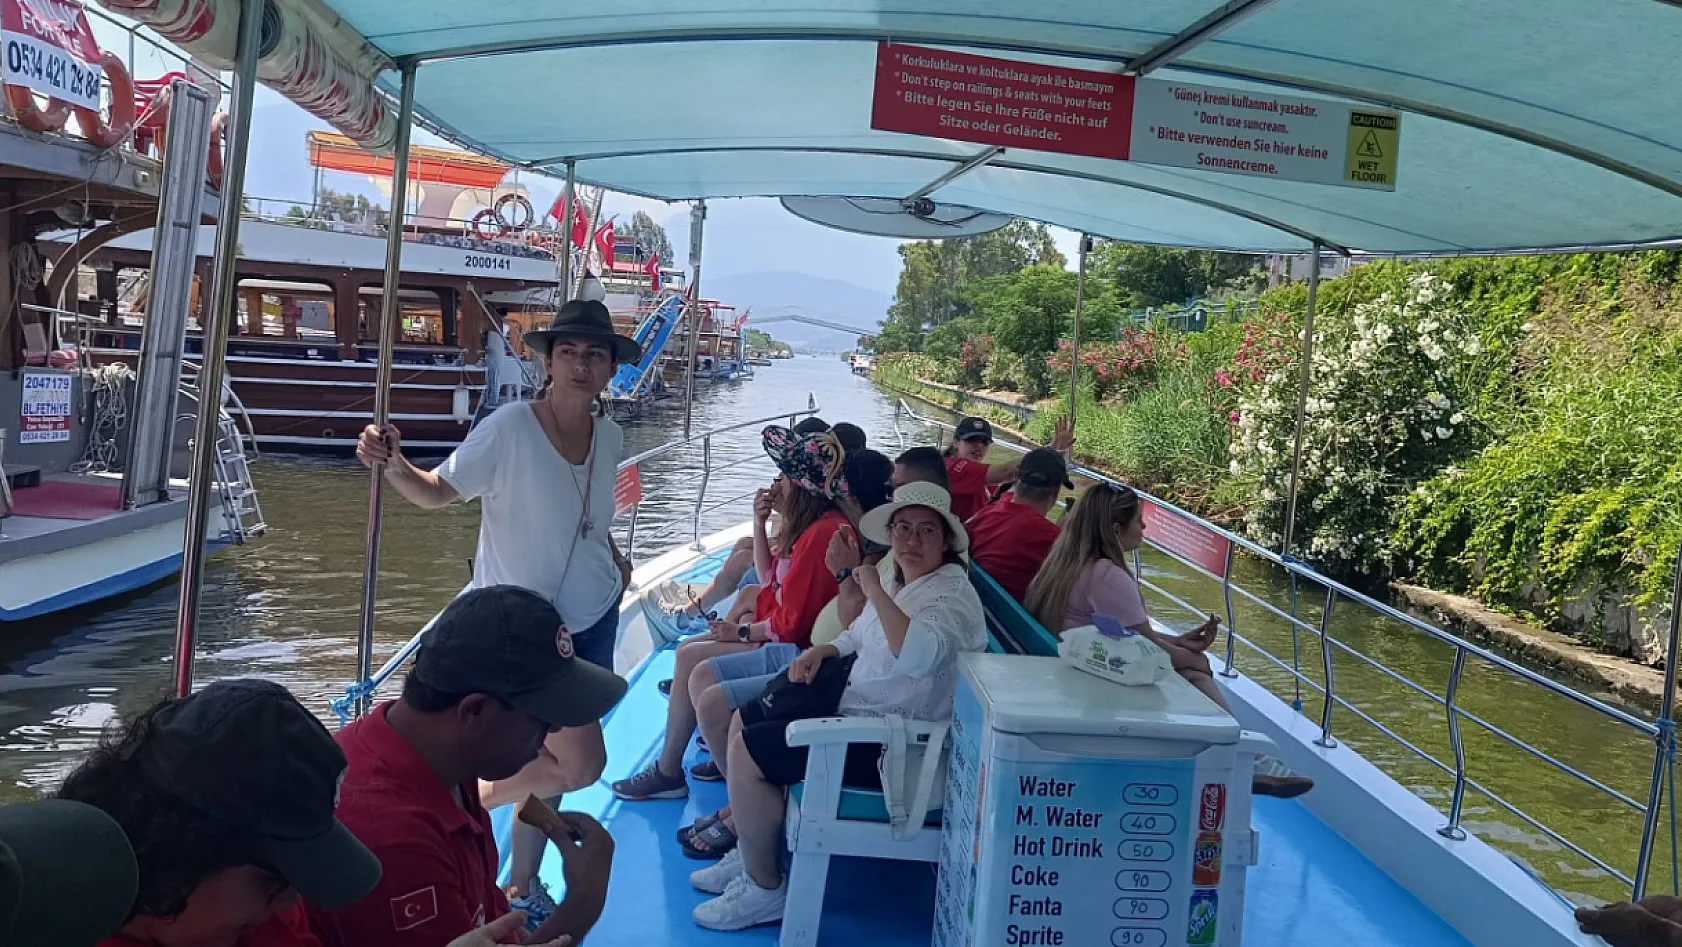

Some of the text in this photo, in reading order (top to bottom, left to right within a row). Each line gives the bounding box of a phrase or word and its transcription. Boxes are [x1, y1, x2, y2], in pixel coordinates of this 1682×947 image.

[21, 12, 54, 40] FOR
[8, 40, 43, 80] 0534
[45, 54, 66, 90] 421
[85, 70, 99, 99] 84
[902, 53, 965, 74] Korkuluklara
[966, 65, 978, 75] ve
[979, 64, 1029, 82] koltuklara
[1030, 73, 1053, 87] ayak
[1054, 75, 1067, 87] ile
[901, 72, 1112, 111] Don't step on railings & seats with your feets
[1174, 88, 1202, 105] Güneş
[1204, 91, 1230, 105] kremi
[1231, 94, 1278, 113] kullanmak
[904, 90, 1108, 129] Bitte legen Sie Ihre Füße nicht auf
[939, 115, 1062, 141] Sitze oder Geländer.
[1200, 111, 1289, 134] Don't use suncream.
[1157, 127, 1328, 159] Bitte verwenden Sie hier keine
[1197, 152, 1278, 174] Sonnencreme.
[1358, 160, 1379, 172] WET
[465, 255, 510, 270] 2000141
[25, 376, 69, 389] 2047179
[1018, 776, 1160, 800] Water 30
[1016, 806, 1156, 830] M. Water 40
[1013, 835, 1154, 858] Hot Drink 50
[1011, 865, 1150, 888] Coke 90
[1009, 894, 1148, 916] Fanta 90
[1006, 925, 1144, 947] Sprite 90
